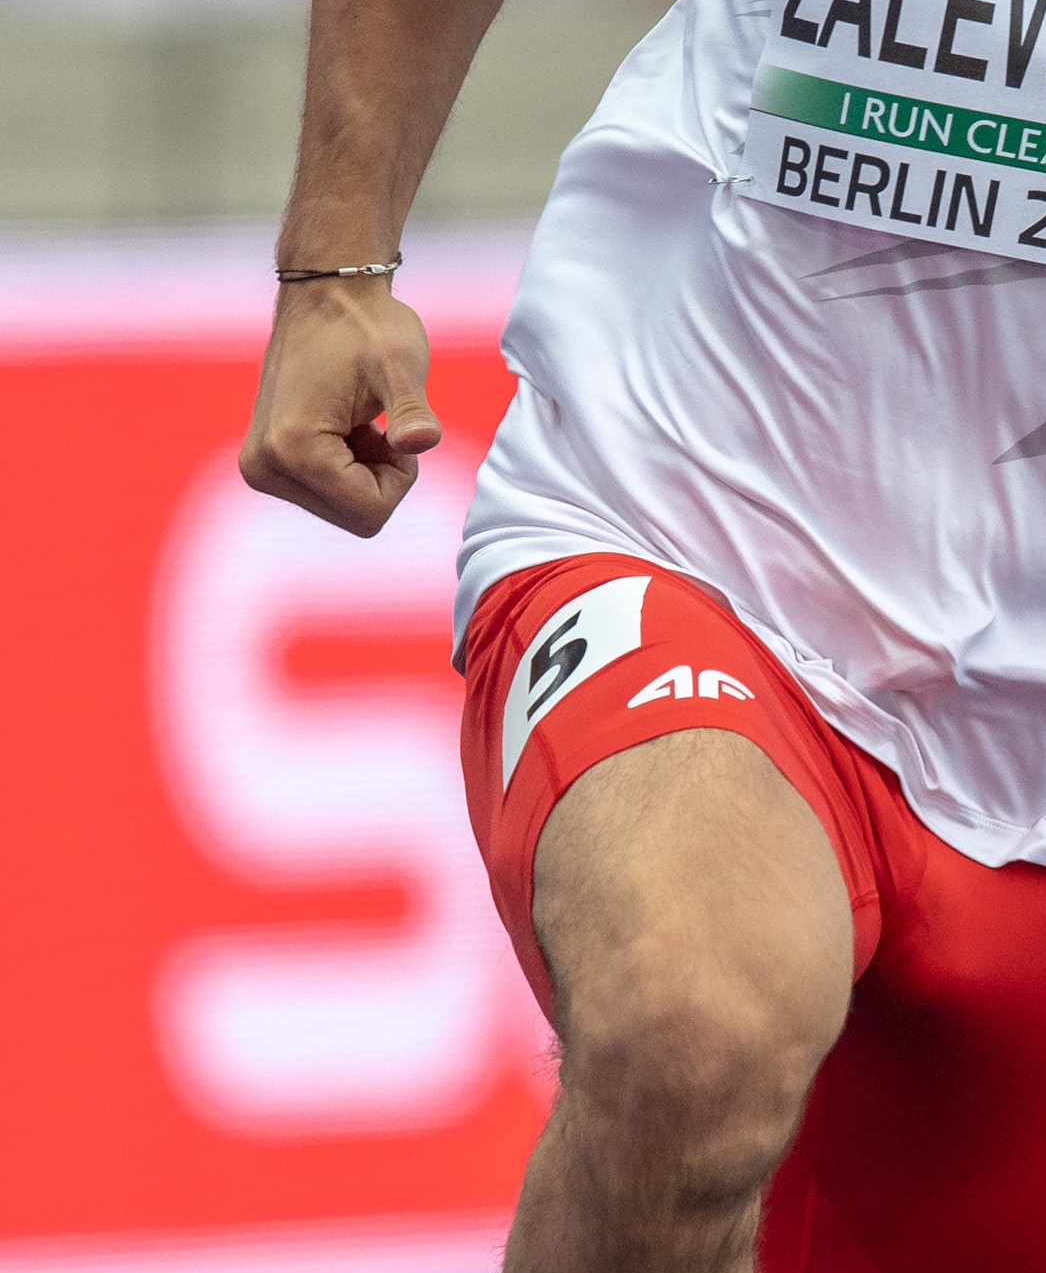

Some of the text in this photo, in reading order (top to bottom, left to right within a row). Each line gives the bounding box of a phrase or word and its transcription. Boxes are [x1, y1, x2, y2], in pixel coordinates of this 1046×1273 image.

[839, 92, 851, 125] I
[861, 97, 954, 146] RUN
[776, 135, 1000, 238] BERLIN
[526, 608, 588, 722] 5
